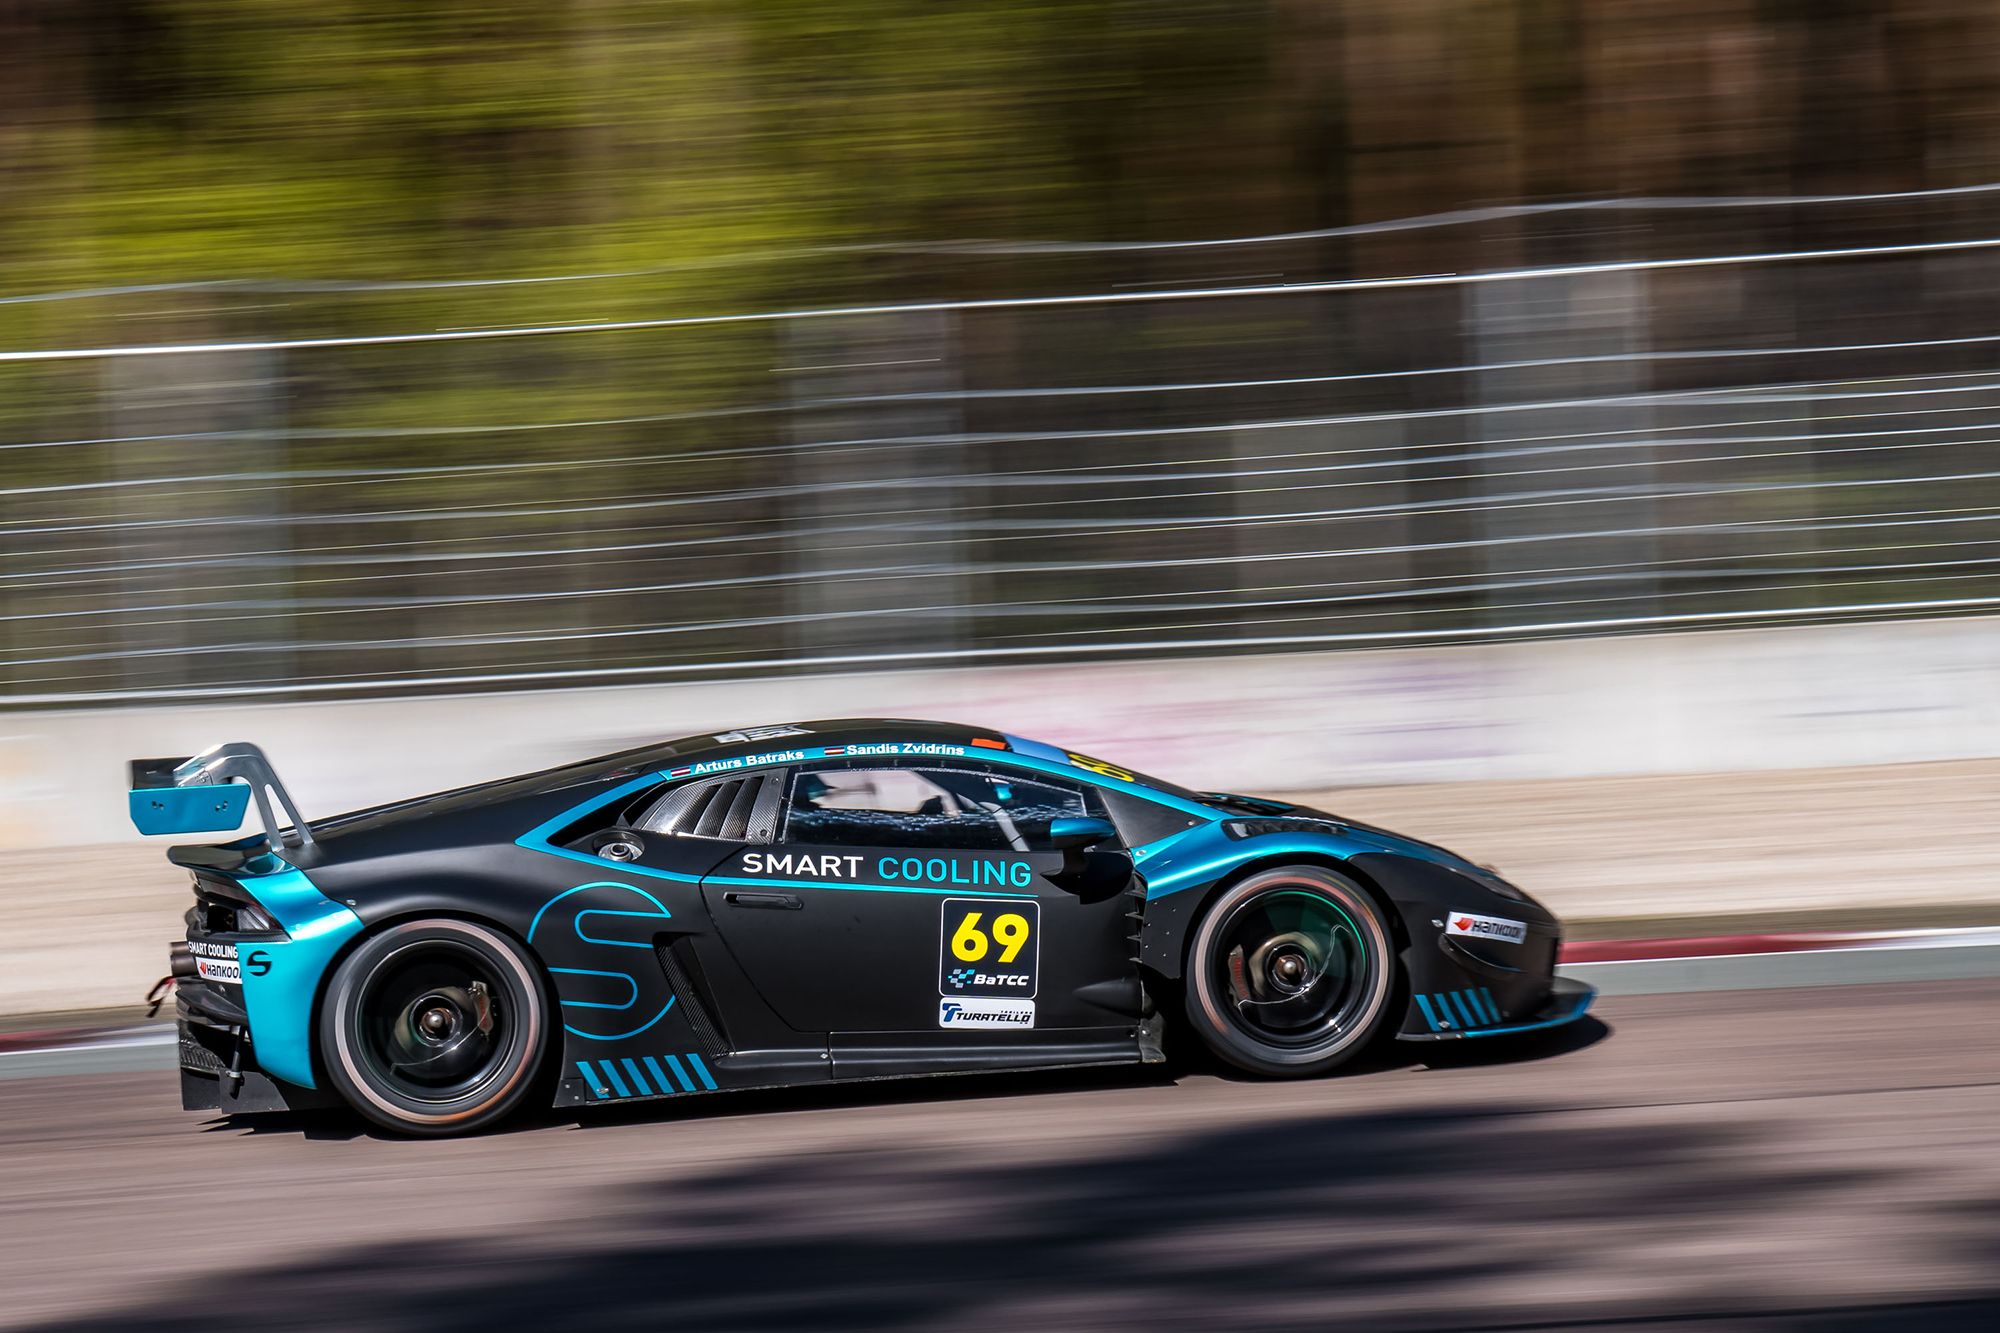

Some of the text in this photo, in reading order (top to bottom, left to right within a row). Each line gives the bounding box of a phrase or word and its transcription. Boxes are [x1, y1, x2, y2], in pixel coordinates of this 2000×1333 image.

[846, 743, 965, 756] Sandis Zvidrins
[694, 751, 804, 774] Arturs Batraks
[741, 853, 1032, 888] SMART COOLING
[951, 912, 1030, 964] 69
[187, 941, 239, 959] SMART COOLING
[973, 974, 1030, 986] BaTCC
[956, 1012, 1032, 1023] TURATELLO
